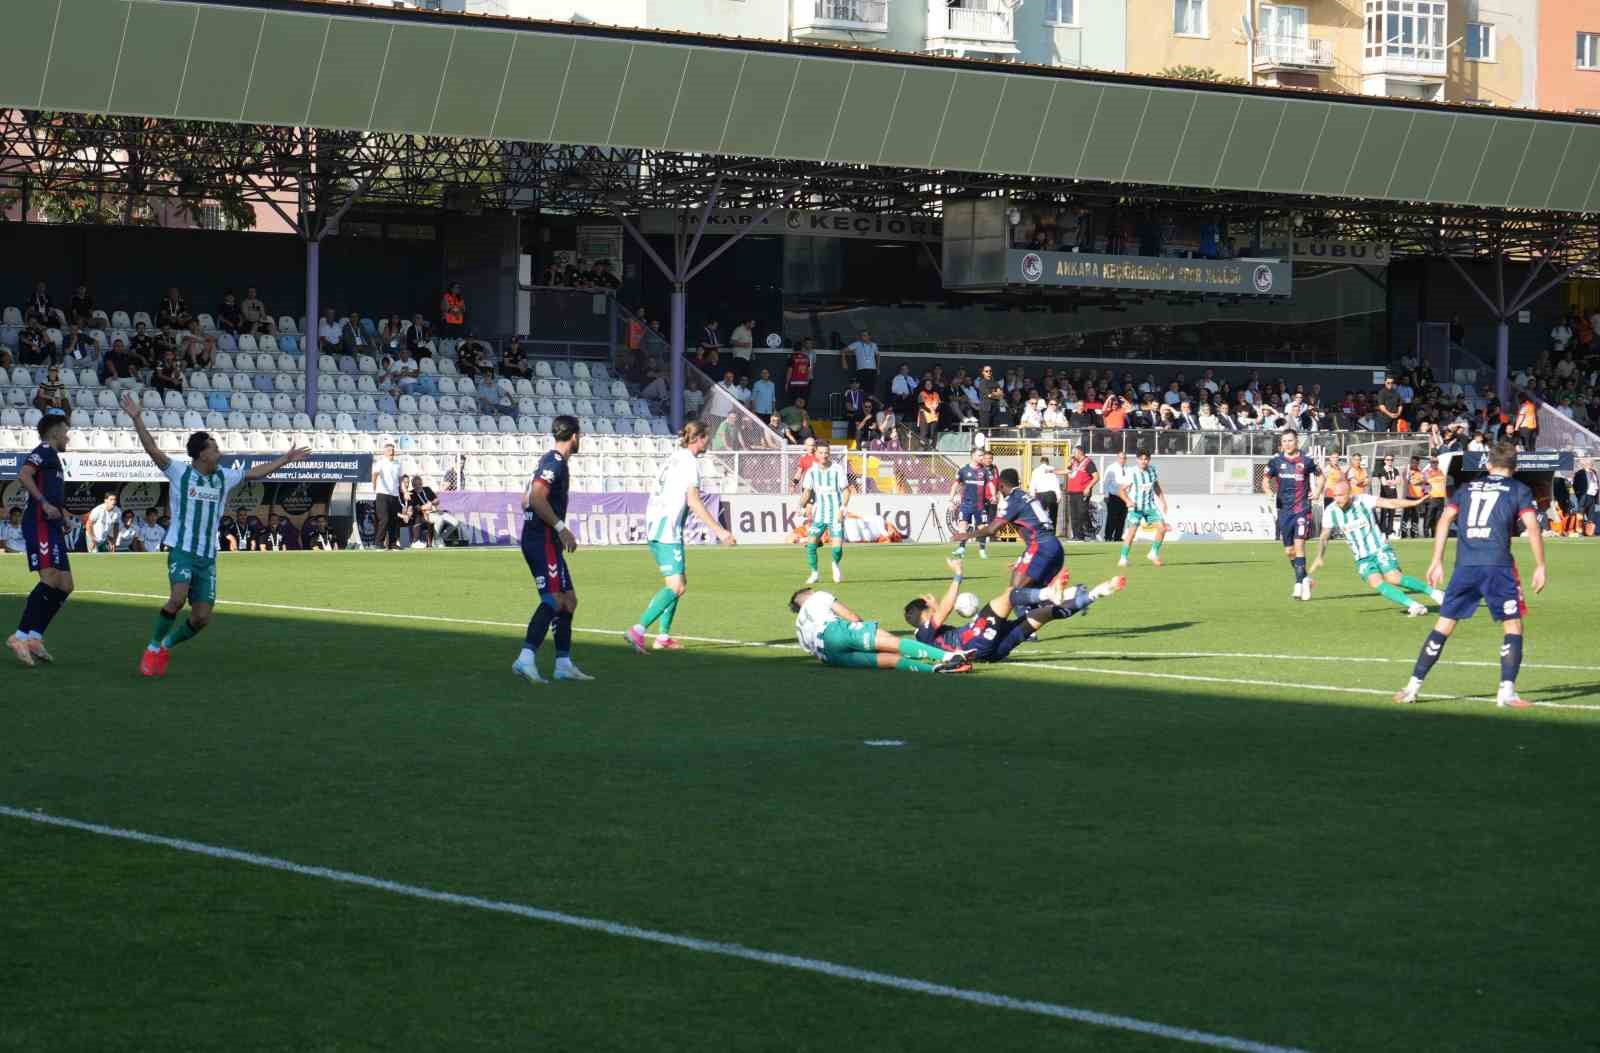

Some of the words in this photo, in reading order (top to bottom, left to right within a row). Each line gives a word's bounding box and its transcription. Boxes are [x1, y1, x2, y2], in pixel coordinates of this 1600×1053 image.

[1056, 260, 1099, 279] ANKARA
[79, 459, 107, 467] ANKARA
[1467, 491, 1500, 528] 17
